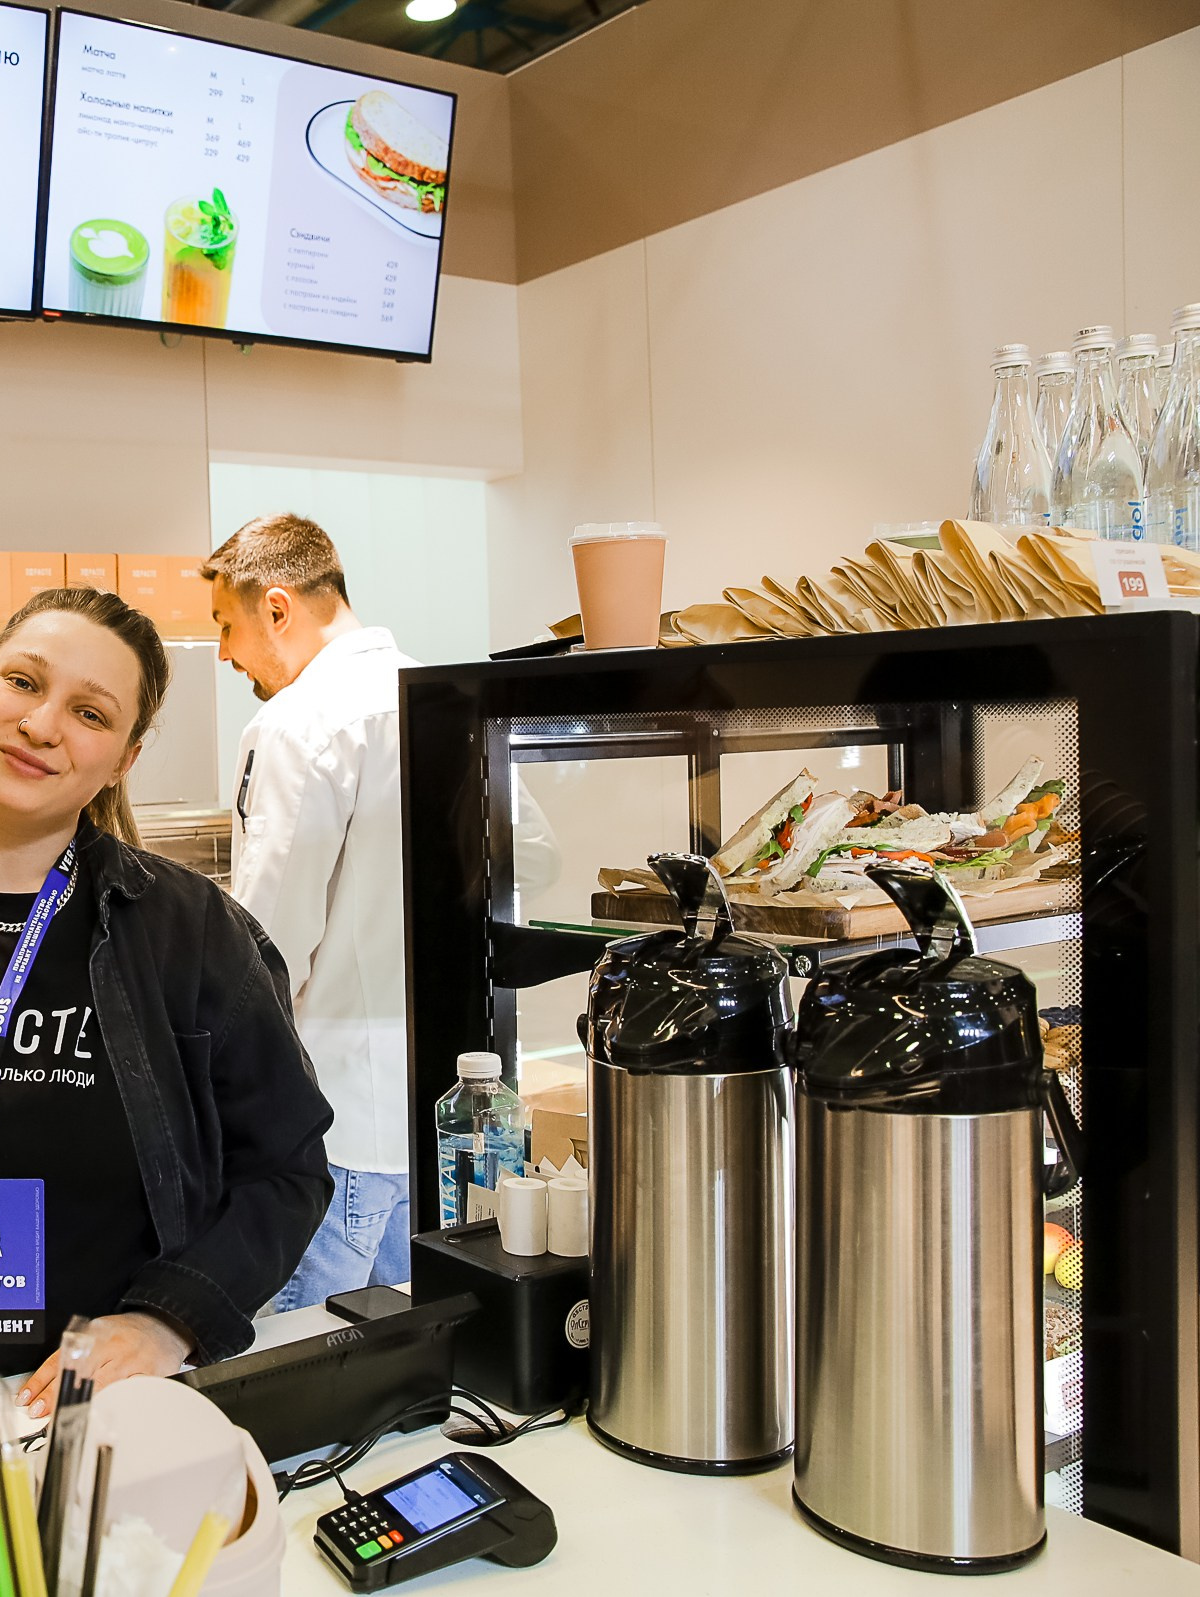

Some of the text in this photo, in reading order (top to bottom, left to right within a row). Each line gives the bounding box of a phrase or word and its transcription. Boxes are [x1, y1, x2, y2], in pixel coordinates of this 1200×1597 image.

[83, 45, 116, 60] Матча
[80, 90, 173, 117] Холодные напитки
[1122, 577, 1144, 591] 199
[49, 1069, 95, 1088] ЛЮДИ
[440, 1148, 457, 1230] AIKAL
